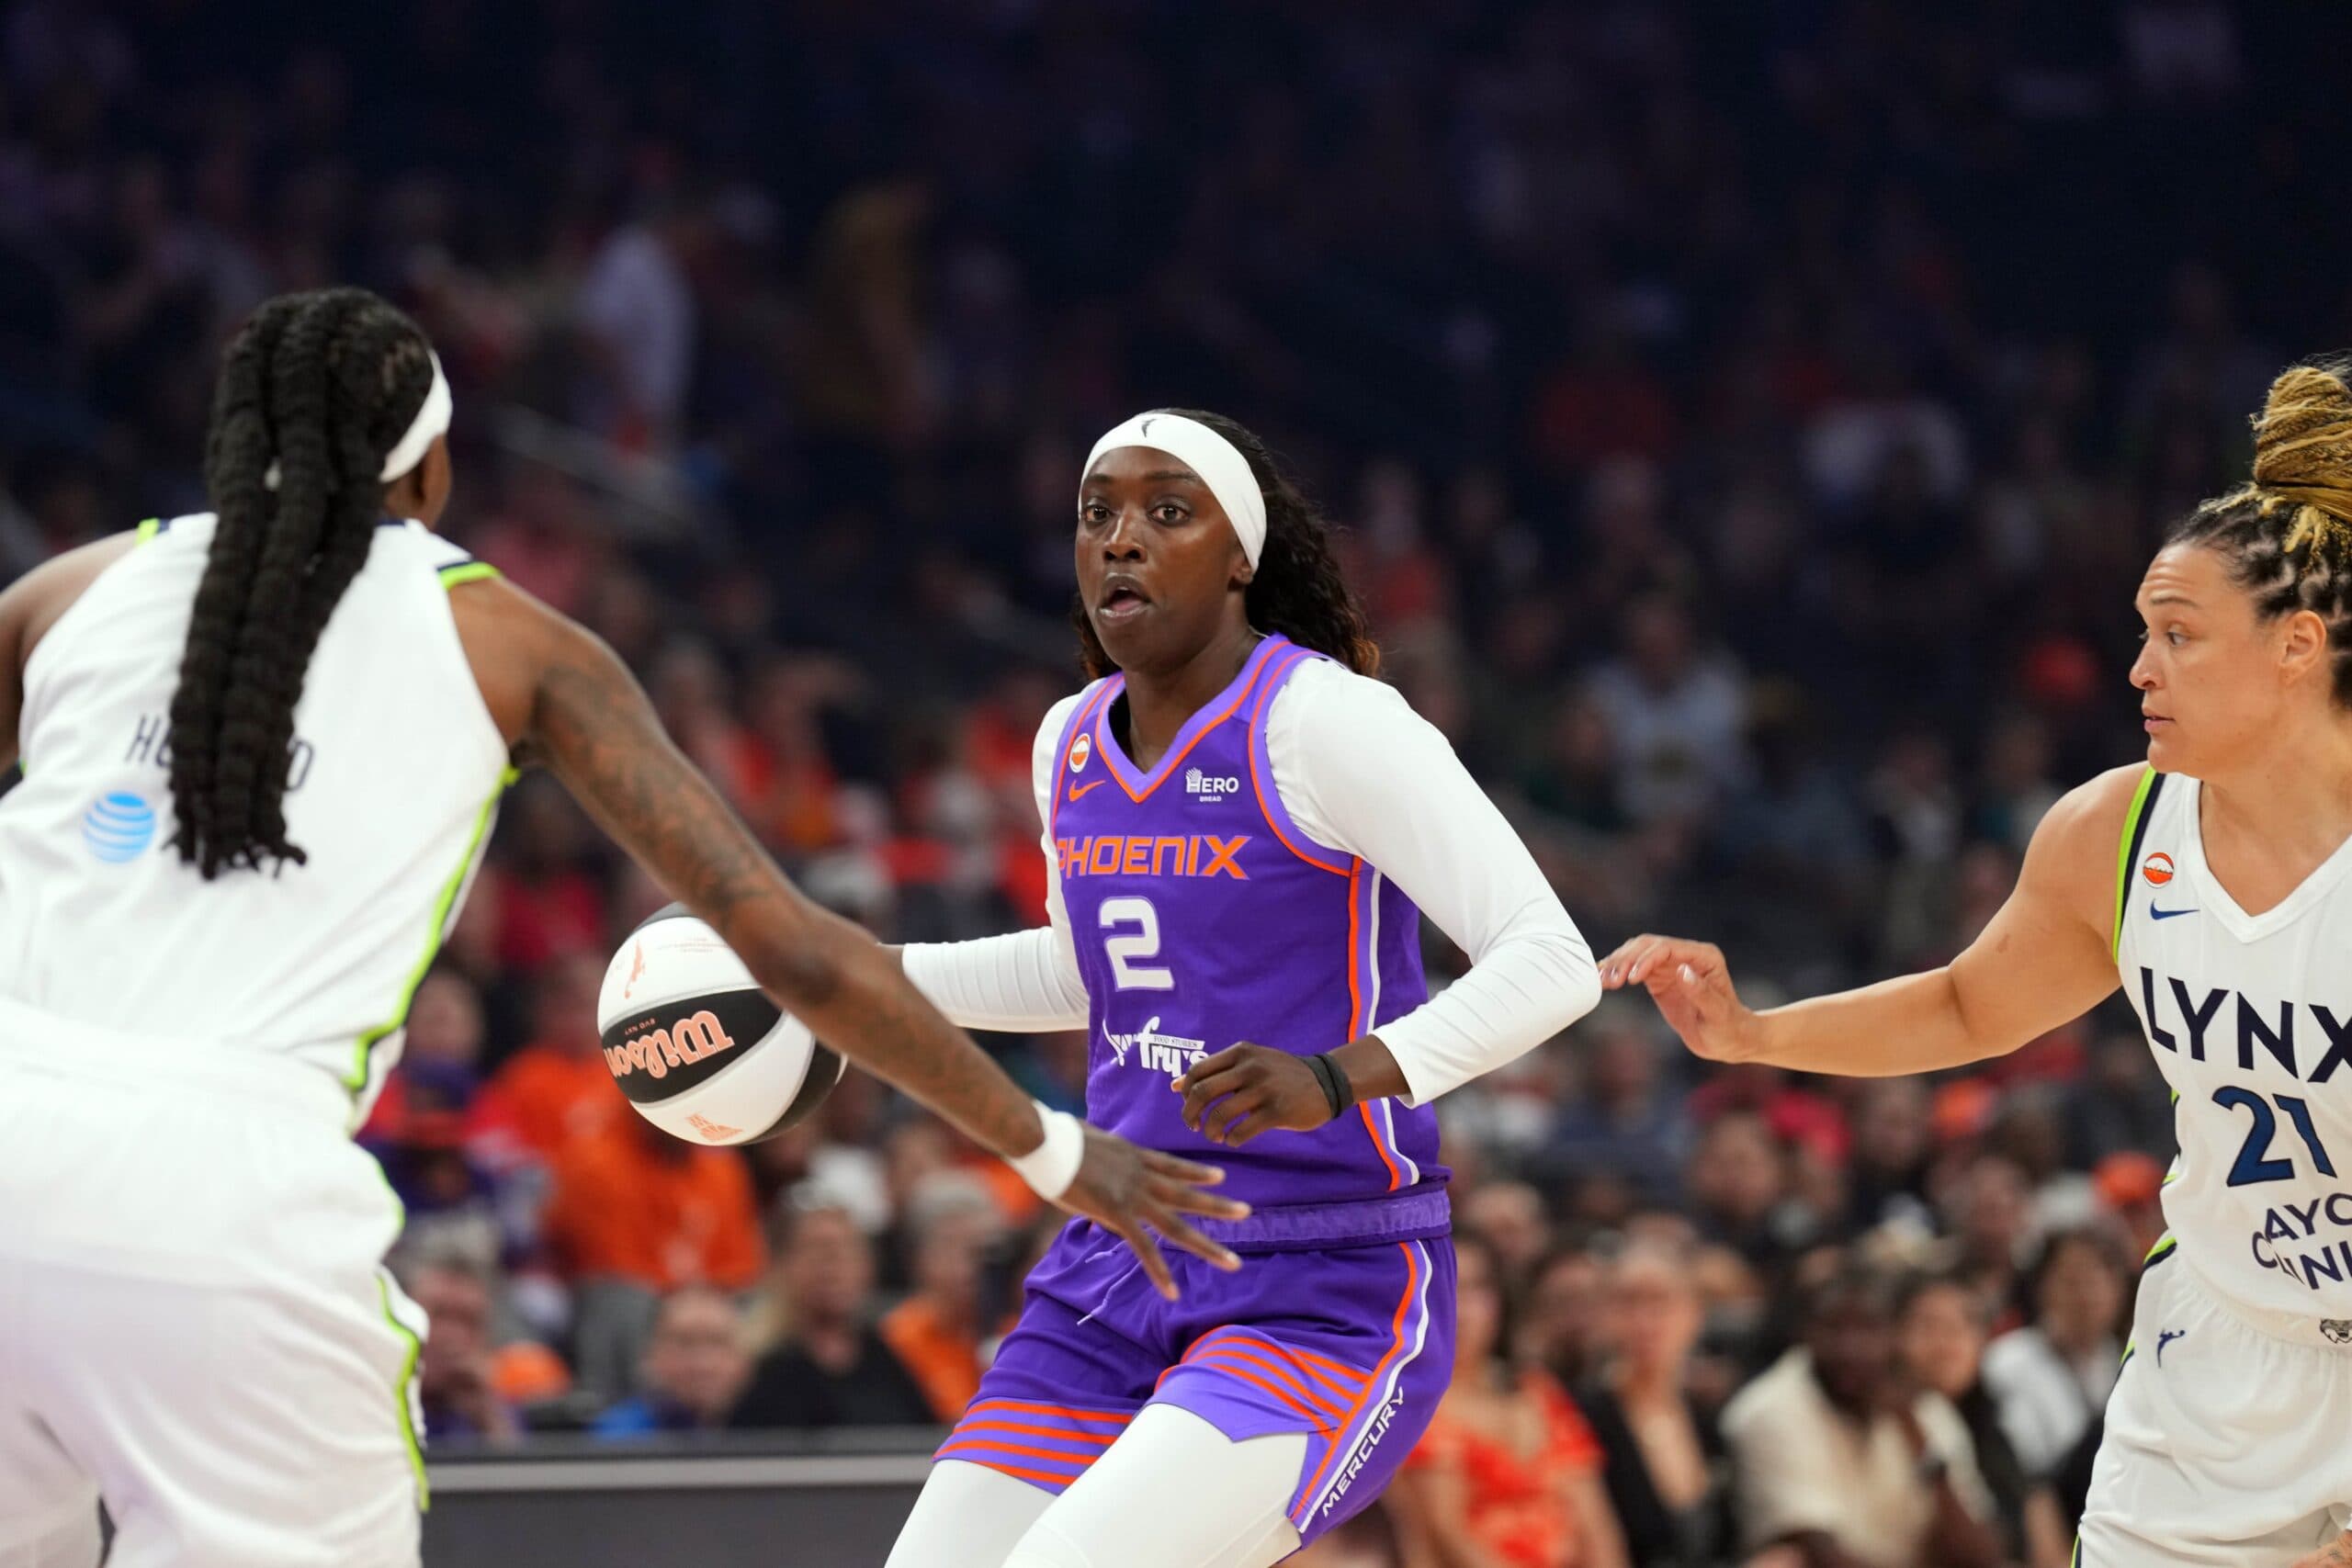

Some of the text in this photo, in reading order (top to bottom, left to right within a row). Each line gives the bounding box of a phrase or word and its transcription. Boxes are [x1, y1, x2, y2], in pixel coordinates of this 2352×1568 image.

[1185, 767, 1239, 794] HERO
[1057, 835, 1253, 881] PHOENIX
[1099, 895, 1175, 992] 2
[603, 1010, 735, 1078] Wilson
[2140, 965, 2352, 1084] LYNX
[2211, 1085, 2338, 1188] 21
[1321, 1385, 1404, 1517] MERCURY
